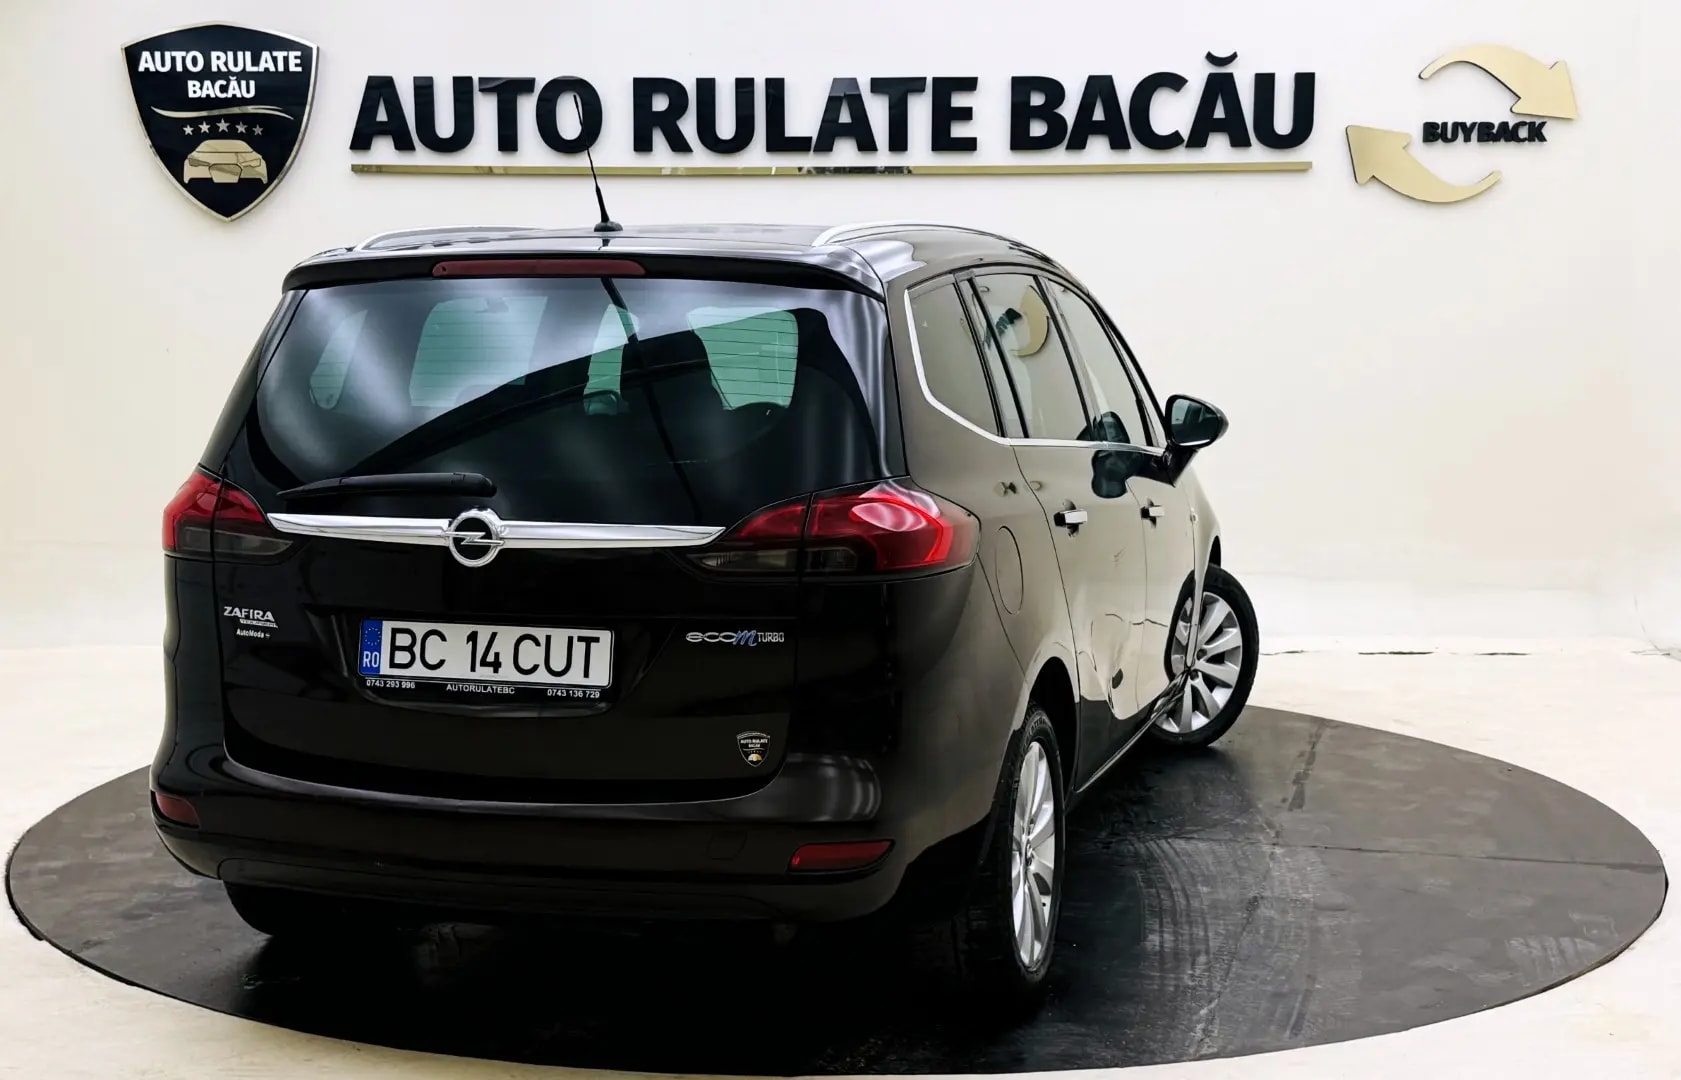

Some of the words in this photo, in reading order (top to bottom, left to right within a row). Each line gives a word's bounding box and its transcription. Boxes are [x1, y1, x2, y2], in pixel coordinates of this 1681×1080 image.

[138, 51, 205, 72] AUTO
[210, 50, 303, 73] RULATE
[187, 75, 256, 98] BACĂU
[349, 75, 603, 154] AUTO
[633, 76, 979, 154] RULATE
[1010, 51, 1316, 151] BACĂU
[1422, 121, 1548, 144] BUYBACK
[223, 606, 275, 622] ZAFIRA
[362, 650, 380, 668] RO
[389, 627, 448, 671] BC
[466, 630, 502, 674] 14
[512, 633, 601, 679] CUT
[366, 679, 385, 688] 0743
[386, 680, 400, 689] 293
[401, 681, 416, 690] 996
[446, 683, 516, 695] AUTORULATEBC
[547, 688, 567, 698] 0743
[569, 690, 584, 698] 136
[585, 690, 600, 699] 729
